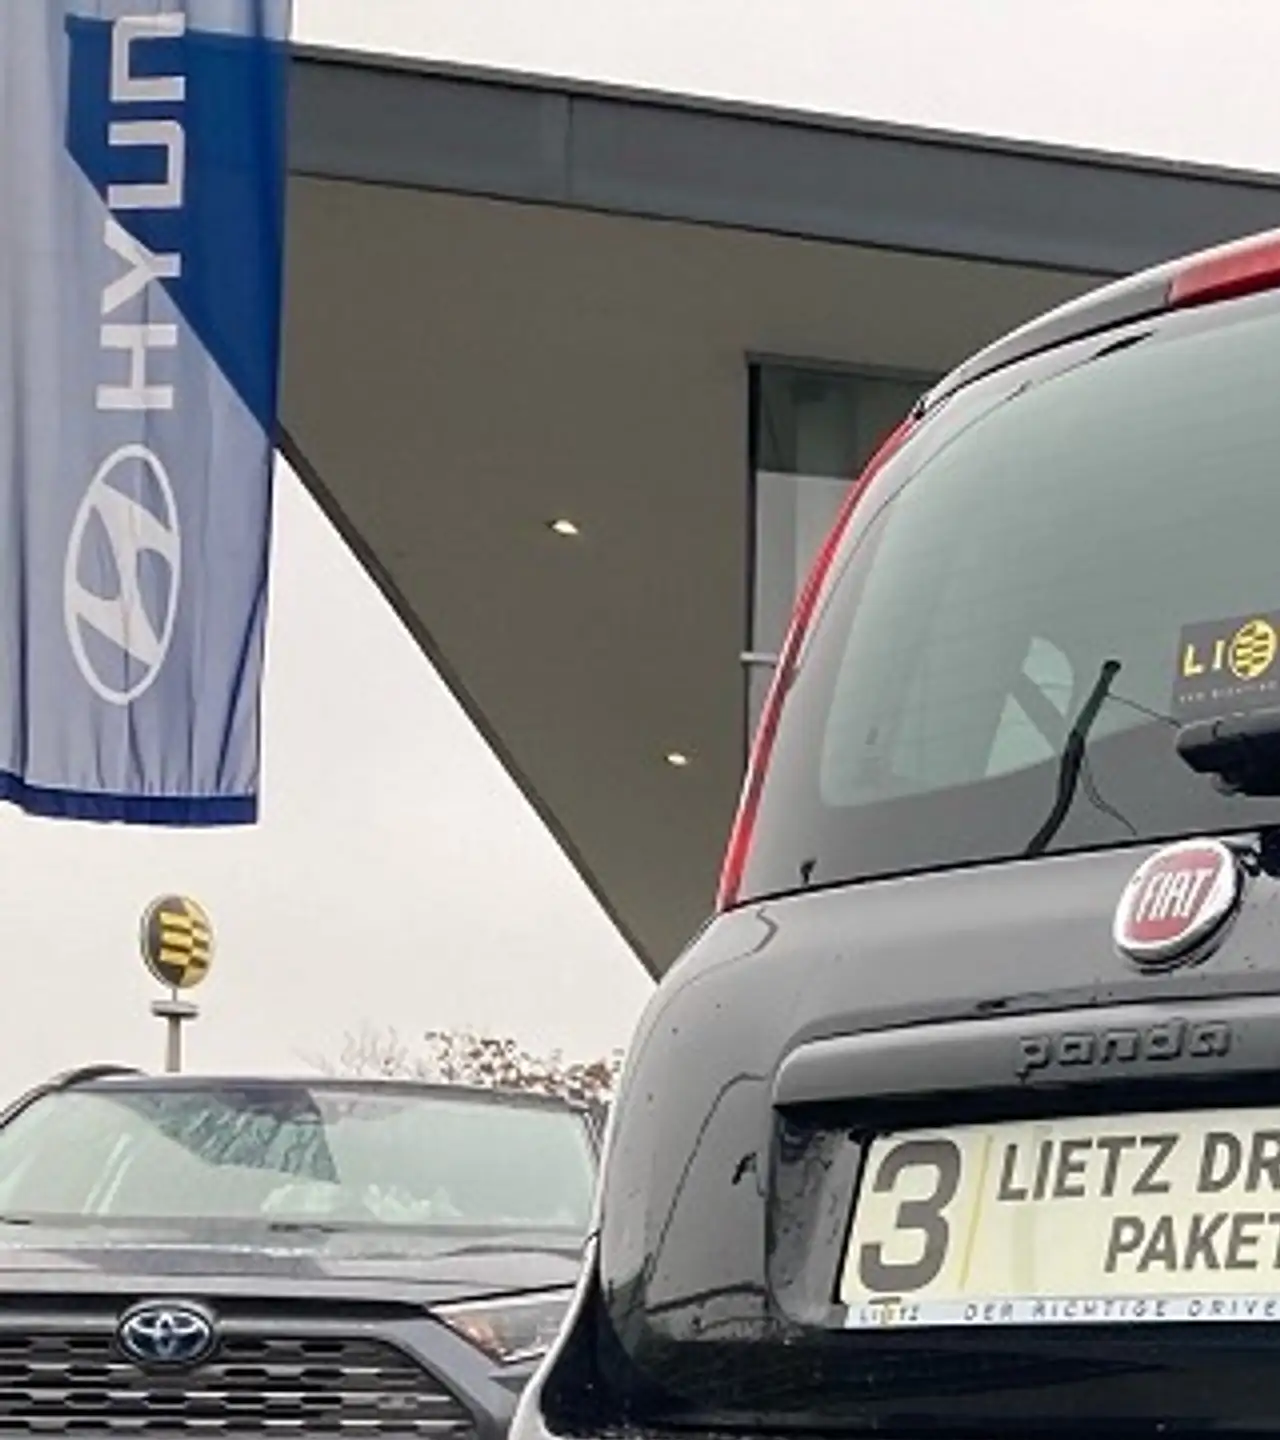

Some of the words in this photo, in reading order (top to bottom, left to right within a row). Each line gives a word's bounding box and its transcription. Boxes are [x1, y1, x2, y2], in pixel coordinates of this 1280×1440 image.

[1136, 867, 1215, 924] FIAT
[1015, 1017, 1233, 1081] panda
[997, 1134, 1180, 1202] LIETZ
[859, 1139, 962, 1293] 3
[1187, 1299, 1278, 1317] DRIVE
